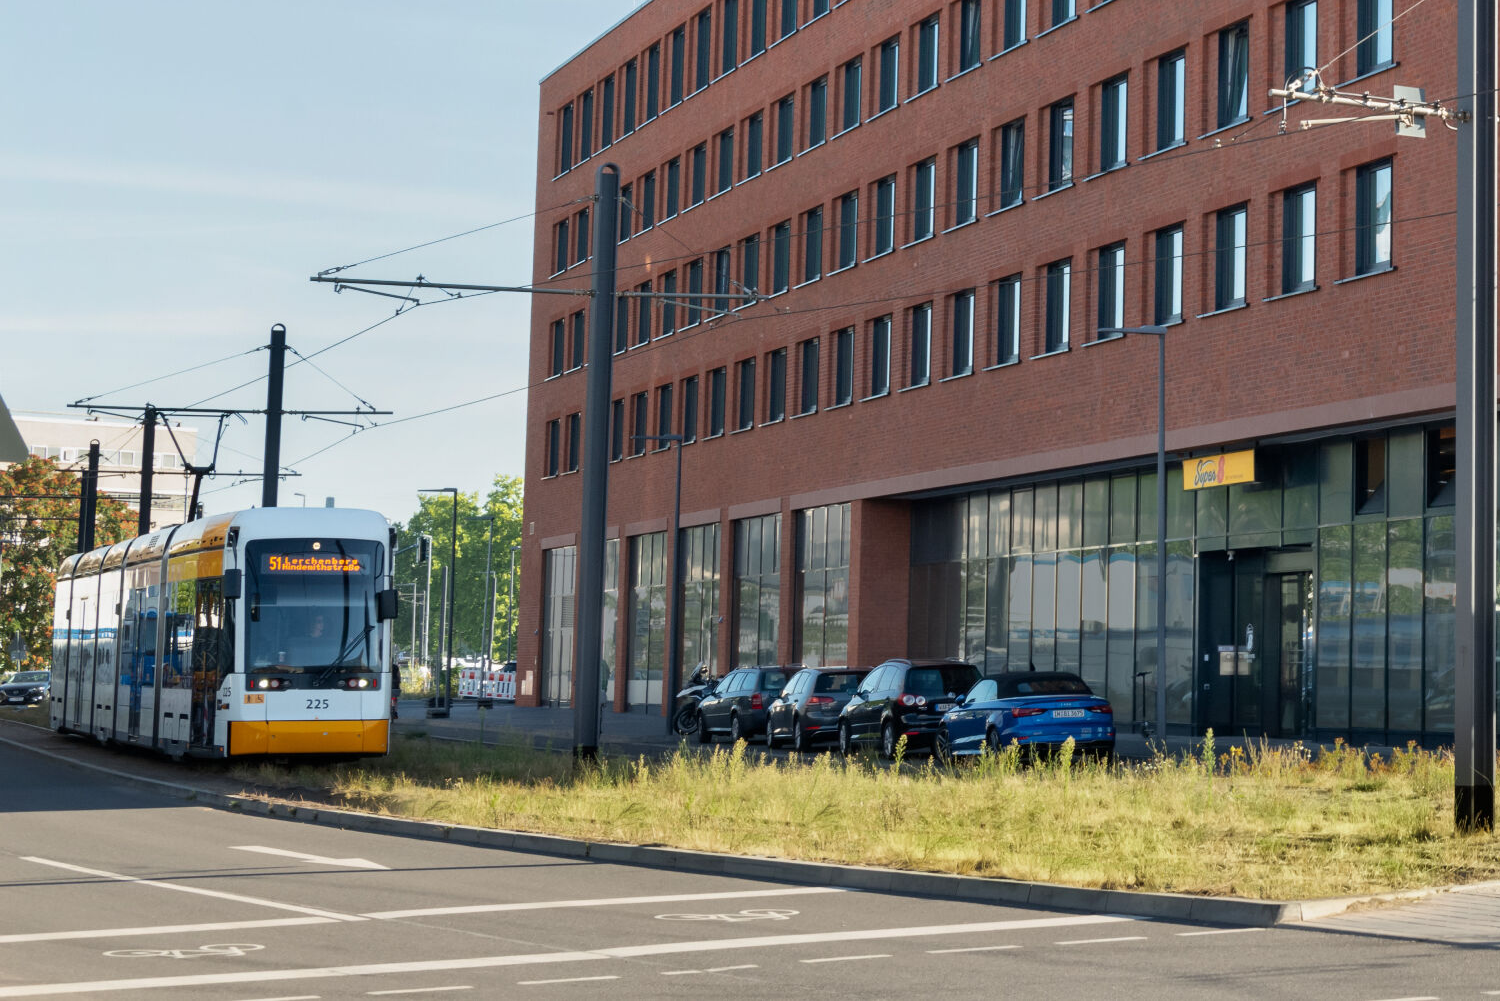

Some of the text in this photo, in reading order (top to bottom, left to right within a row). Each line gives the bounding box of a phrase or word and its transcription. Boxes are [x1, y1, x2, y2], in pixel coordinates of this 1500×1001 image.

[1193, 459, 1217, 488] Super
[268, 556, 359, 571] 51 Lerchenberg
[305, 699, 330, 710] 225
